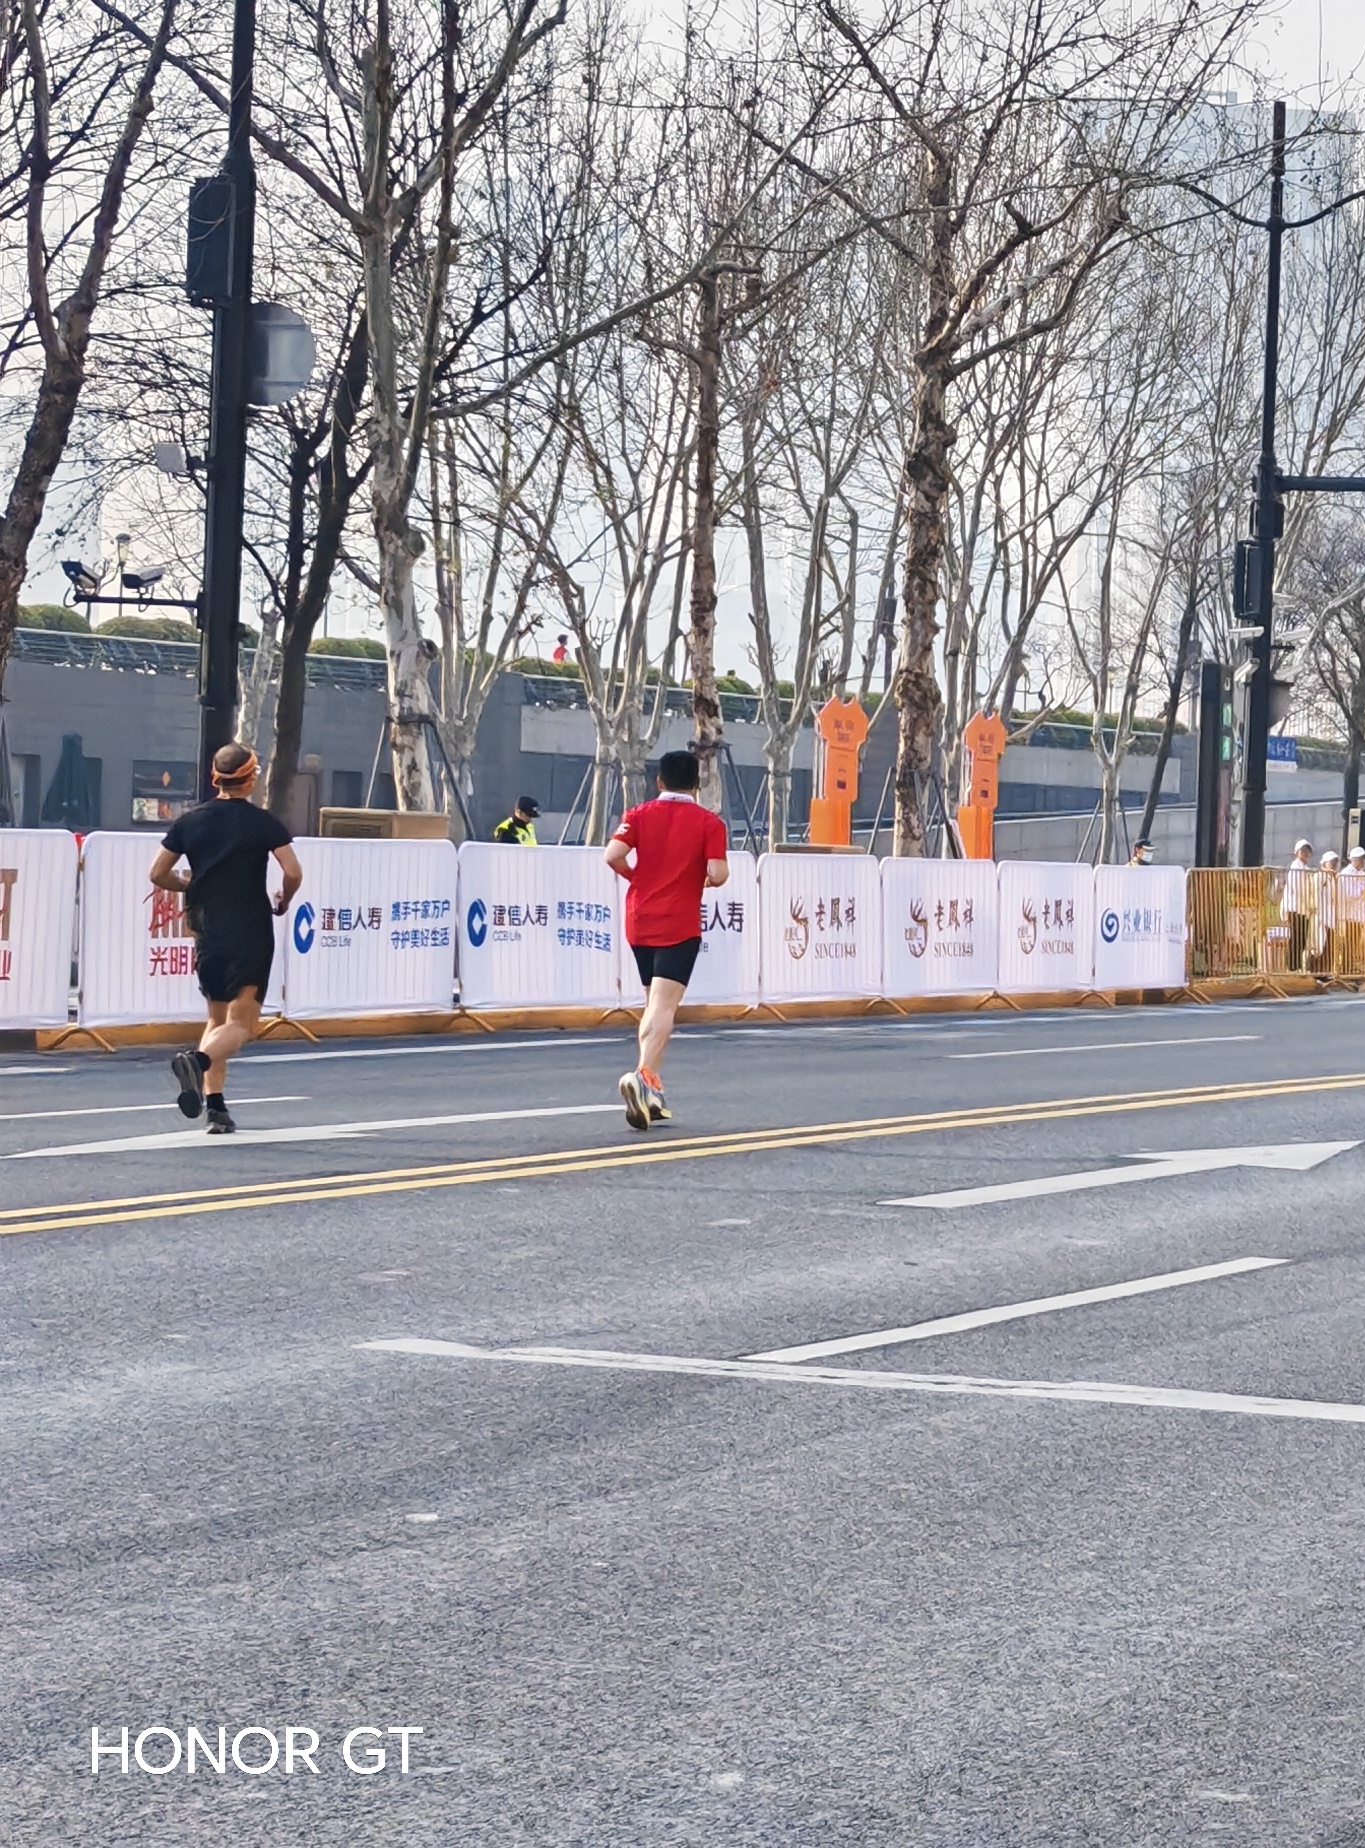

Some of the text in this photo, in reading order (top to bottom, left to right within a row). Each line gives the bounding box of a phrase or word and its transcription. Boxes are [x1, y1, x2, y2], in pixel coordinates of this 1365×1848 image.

[321, 906, 382, 931] 建信人寿
[493, 904, 548, 926] 建信人寿
[149, 946, 197, 976] 光明
